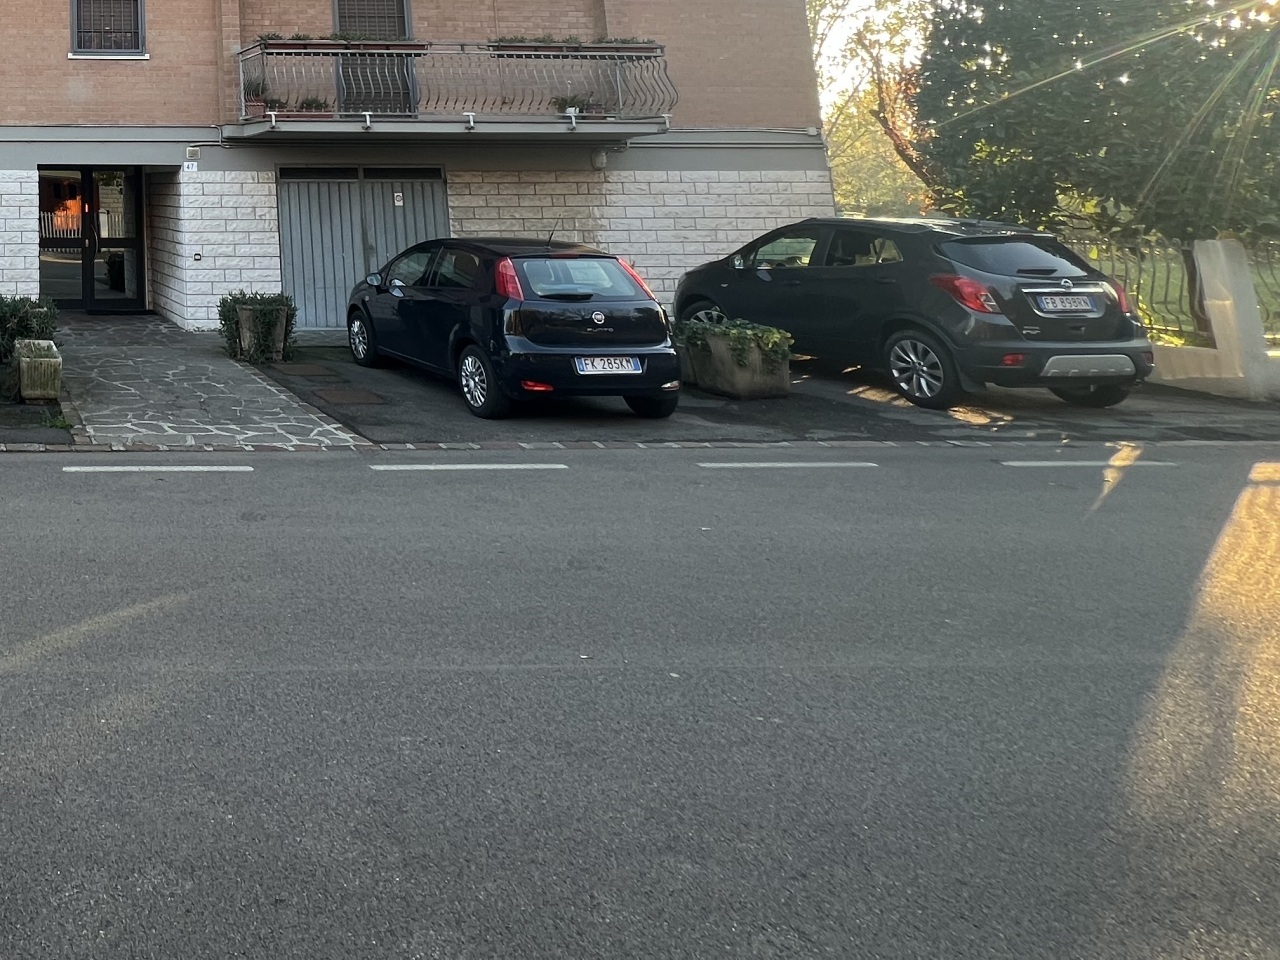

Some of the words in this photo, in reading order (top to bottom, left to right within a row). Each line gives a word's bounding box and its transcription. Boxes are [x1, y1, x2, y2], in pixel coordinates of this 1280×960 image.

[1044, 297, 1057, 308] FB
[584, 358, 597, 369] FK
[600, 358, 633, 369] 285KM
